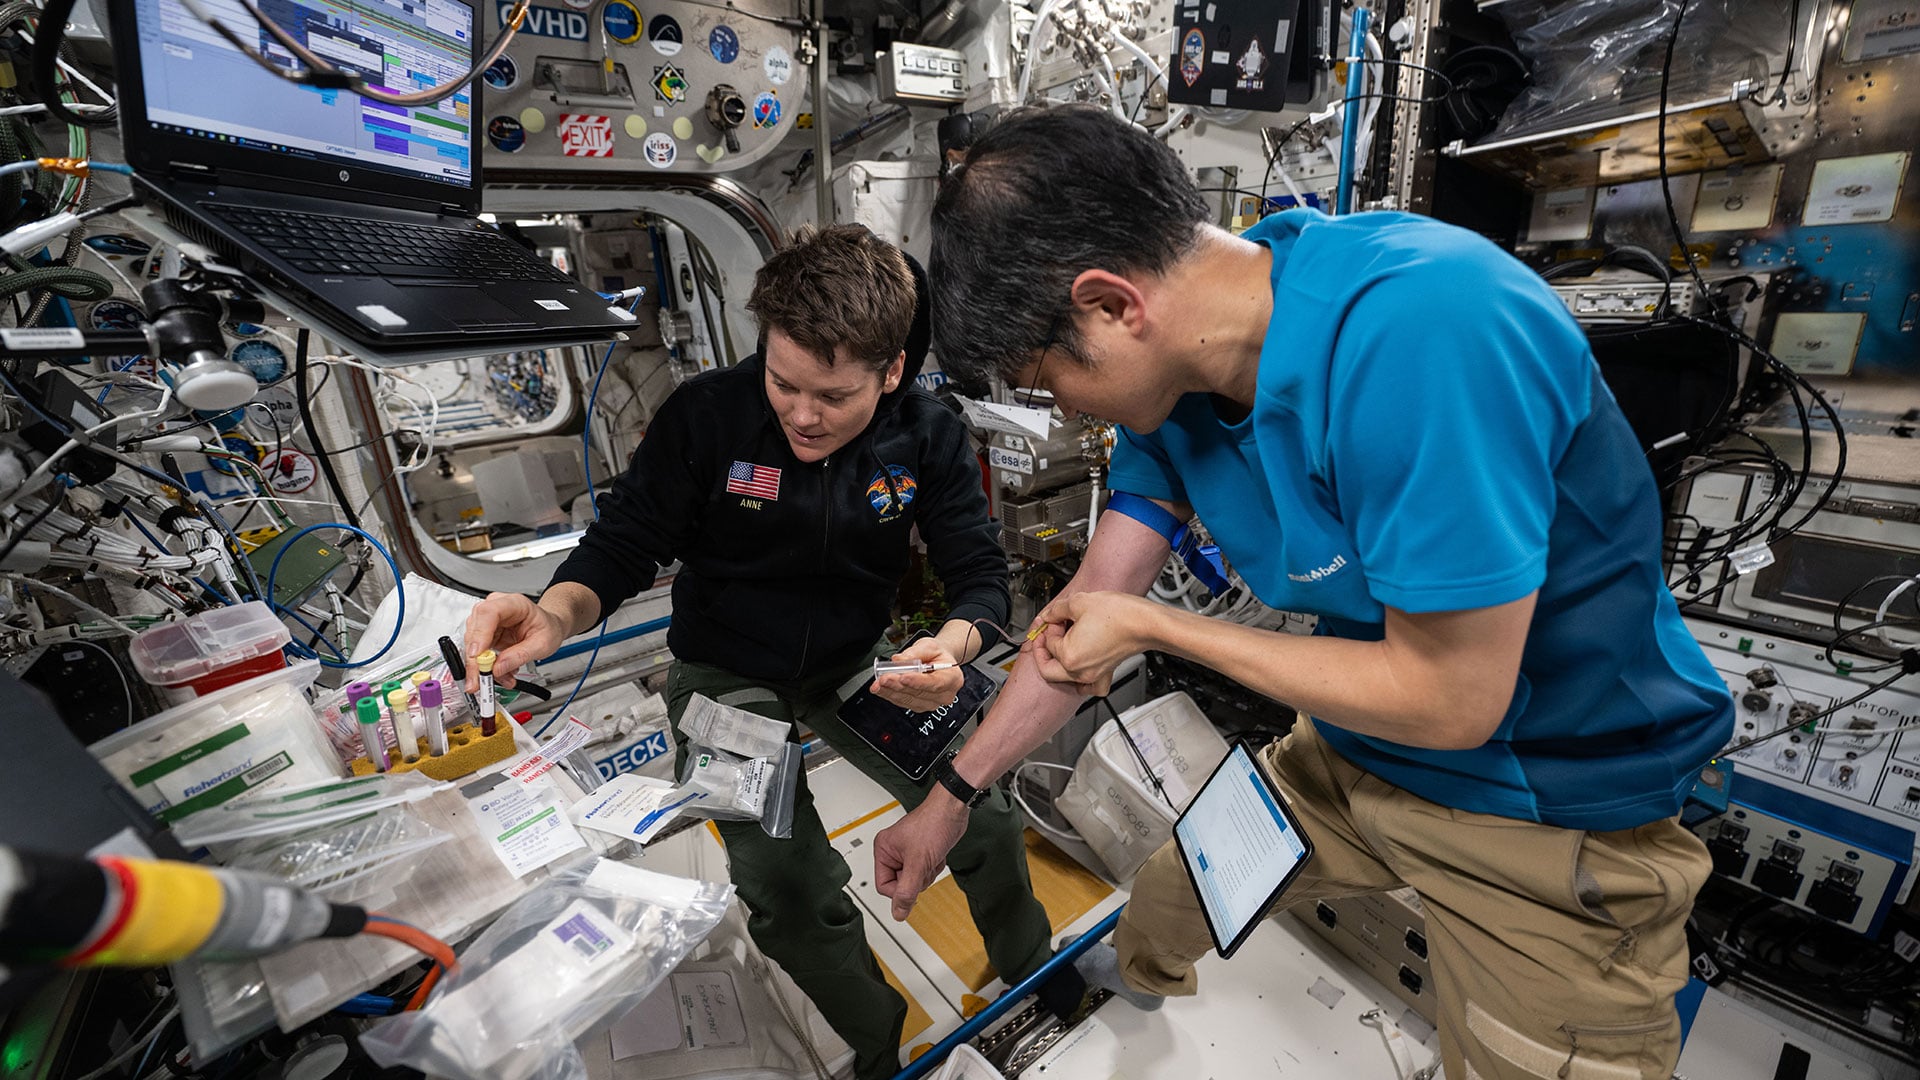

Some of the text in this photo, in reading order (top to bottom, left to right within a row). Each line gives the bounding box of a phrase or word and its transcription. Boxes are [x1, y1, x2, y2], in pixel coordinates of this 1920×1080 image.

[768, 57, 789, 69] alpha
[568, 124, 604, 147] EXIT
[650, 140, 671, 150] iriss
[239, 354, 283, 367] proxima
[917, 373, 944, 390] WD
[1001, 453, 1019, 467] esa
[276, 474, 311, 490] huginn
[739, 498, 763, 511] ANNE
[1845, 699, 1900, 717] APTOP
[598, 733, 666, 781] DECK
[183, 758, 252, 798] Fisherbrand
